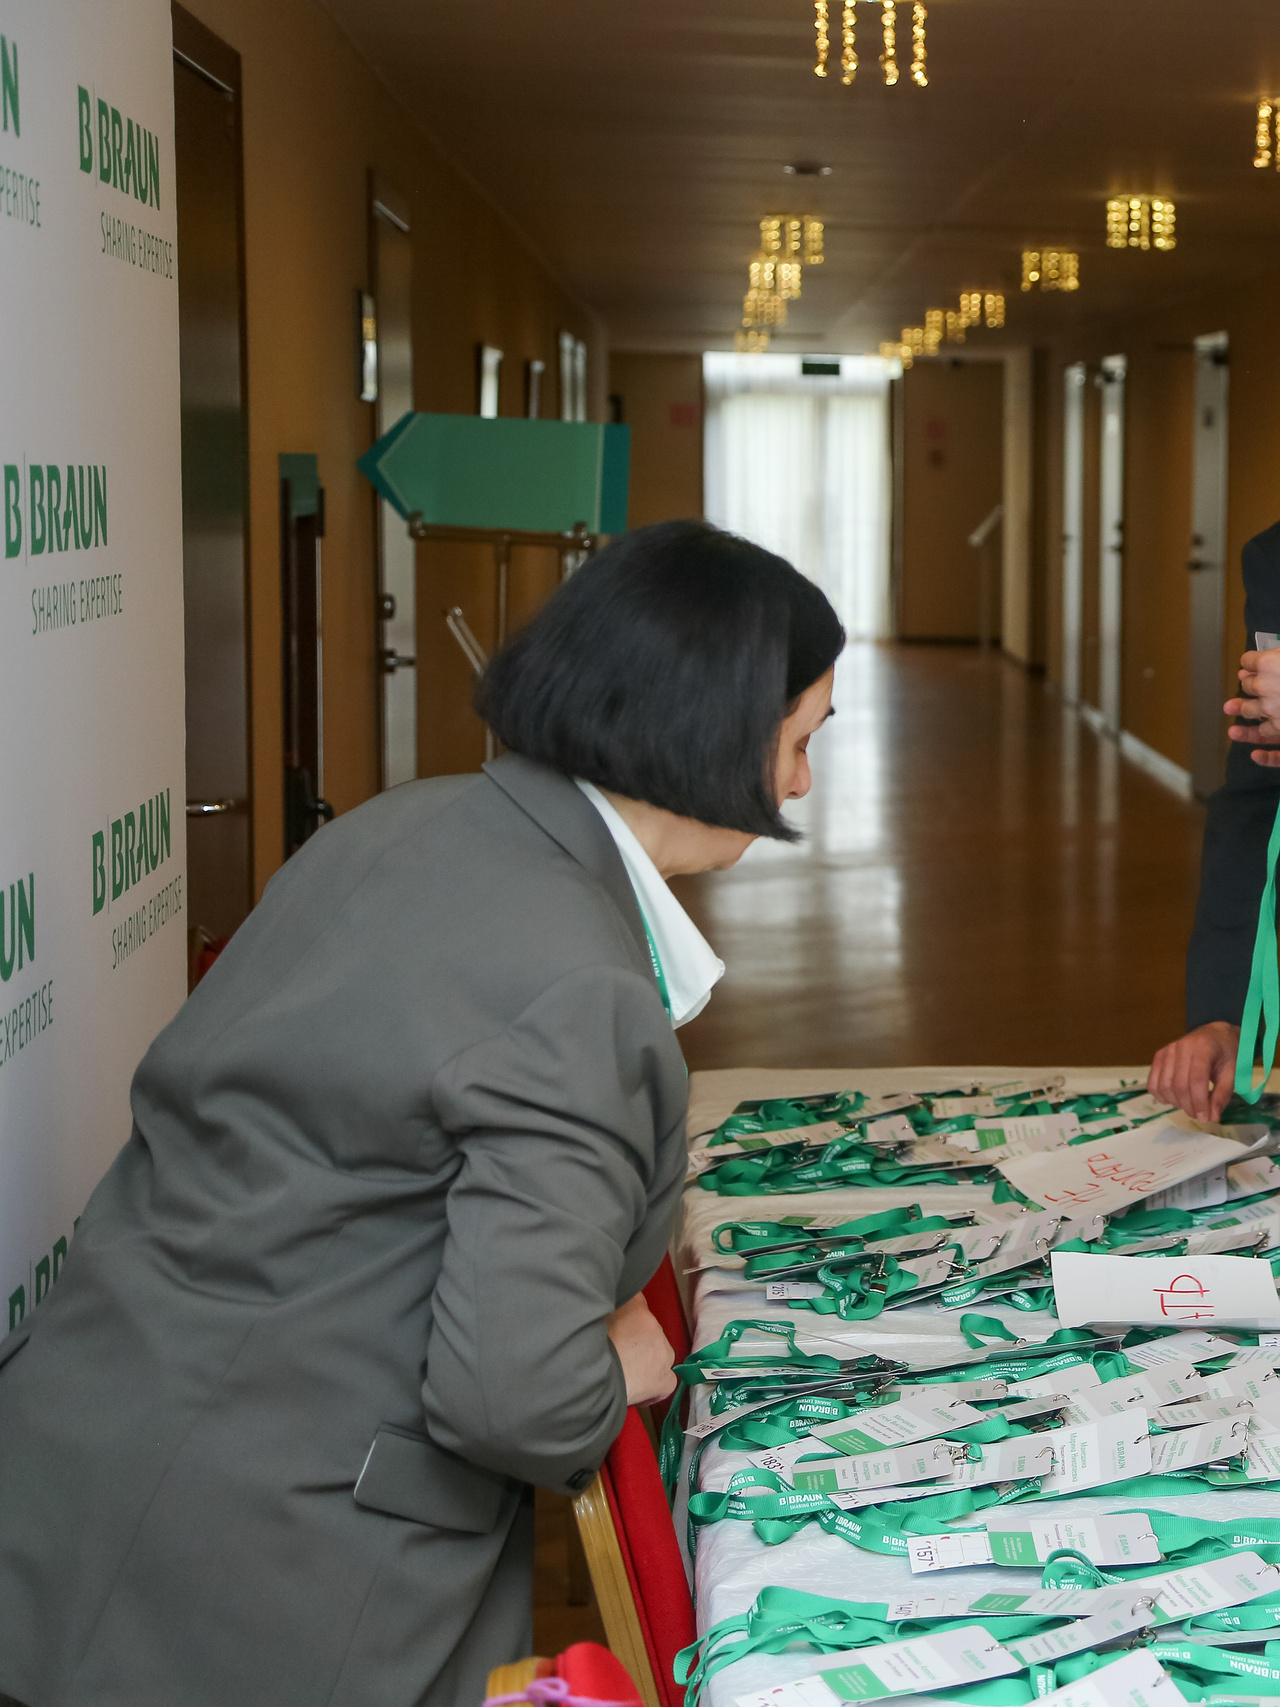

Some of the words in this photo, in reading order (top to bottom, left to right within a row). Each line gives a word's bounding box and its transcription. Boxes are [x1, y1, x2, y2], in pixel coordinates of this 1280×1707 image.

[97, 97, 160, 211] BRAUN
[100, 211, 136, 266] SHARING
[138, 228, 173, 280] EXPERTISE
[29, 464, 108, 556] BRAUN
[31, 581, 77, 635] SHARING
[79, 573, 123, 623] EXPERTISE
[110, 787, 171, 902] BRAUN
[112, 905, 147, 970] SHARING
[149, 875, 182, 938] EXPERTISE
[944, 1290, 969, 1303] BRAUN
[1046, 1357, 1076, 1368] BRAUN
[799, 1404, 831, 1414] BRAUN
[760, 1456, 782, 1469] 183
[787, 1494, 823, 1505] BRAUN
[835, 1514, 862, 1533] BRAUN
[916, 1546, 933, 1562] 157
[1230, 1660, 1270, 1677] BRAUN
[1247, 1658, 1270, 1667] SHARING
